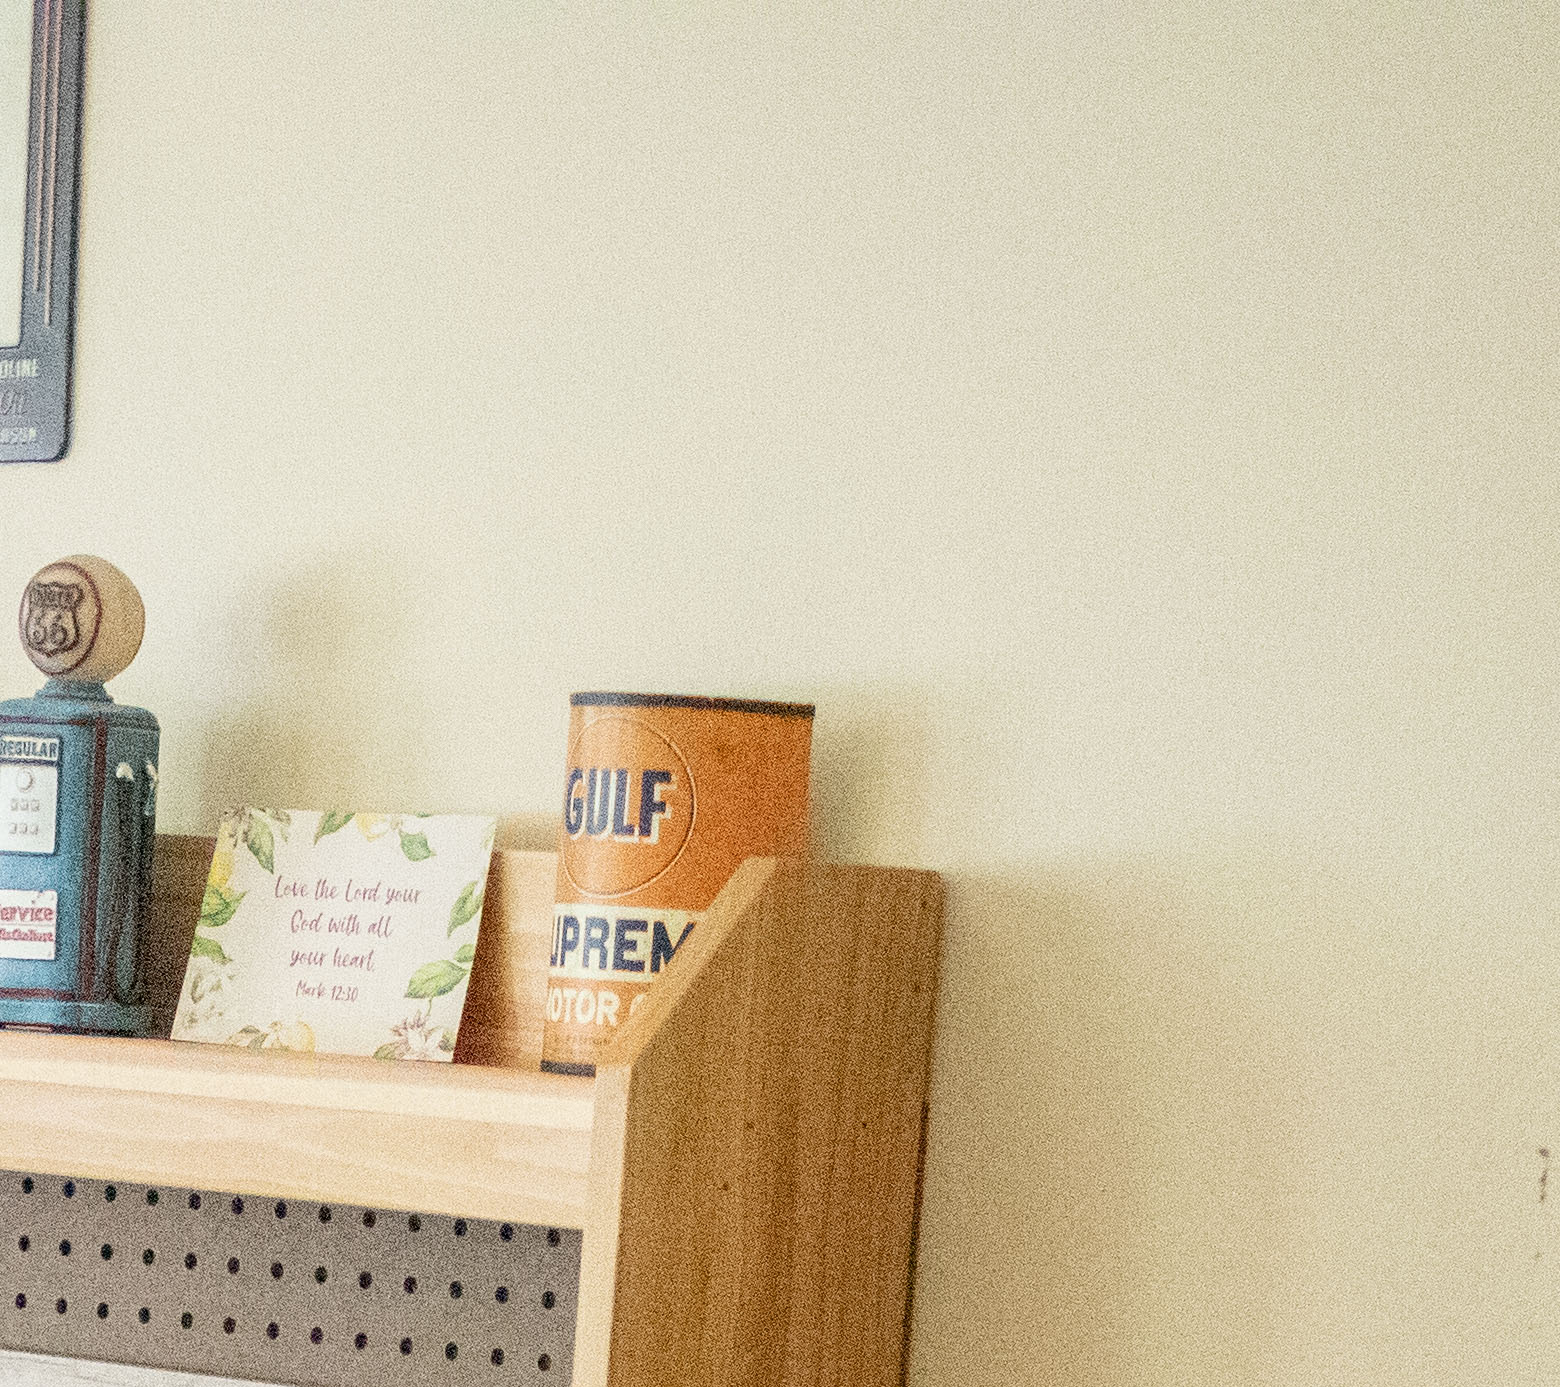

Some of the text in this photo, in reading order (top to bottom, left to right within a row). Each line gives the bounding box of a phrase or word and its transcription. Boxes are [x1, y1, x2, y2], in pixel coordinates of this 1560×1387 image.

[565, 767, 676, 845] GULF
[275, 874, 423, 905] Love the Lord your
[290, 909, 394, 938] God with all
[289, 949, 327, 968] your
[295, 980, 326, 999] Mark
